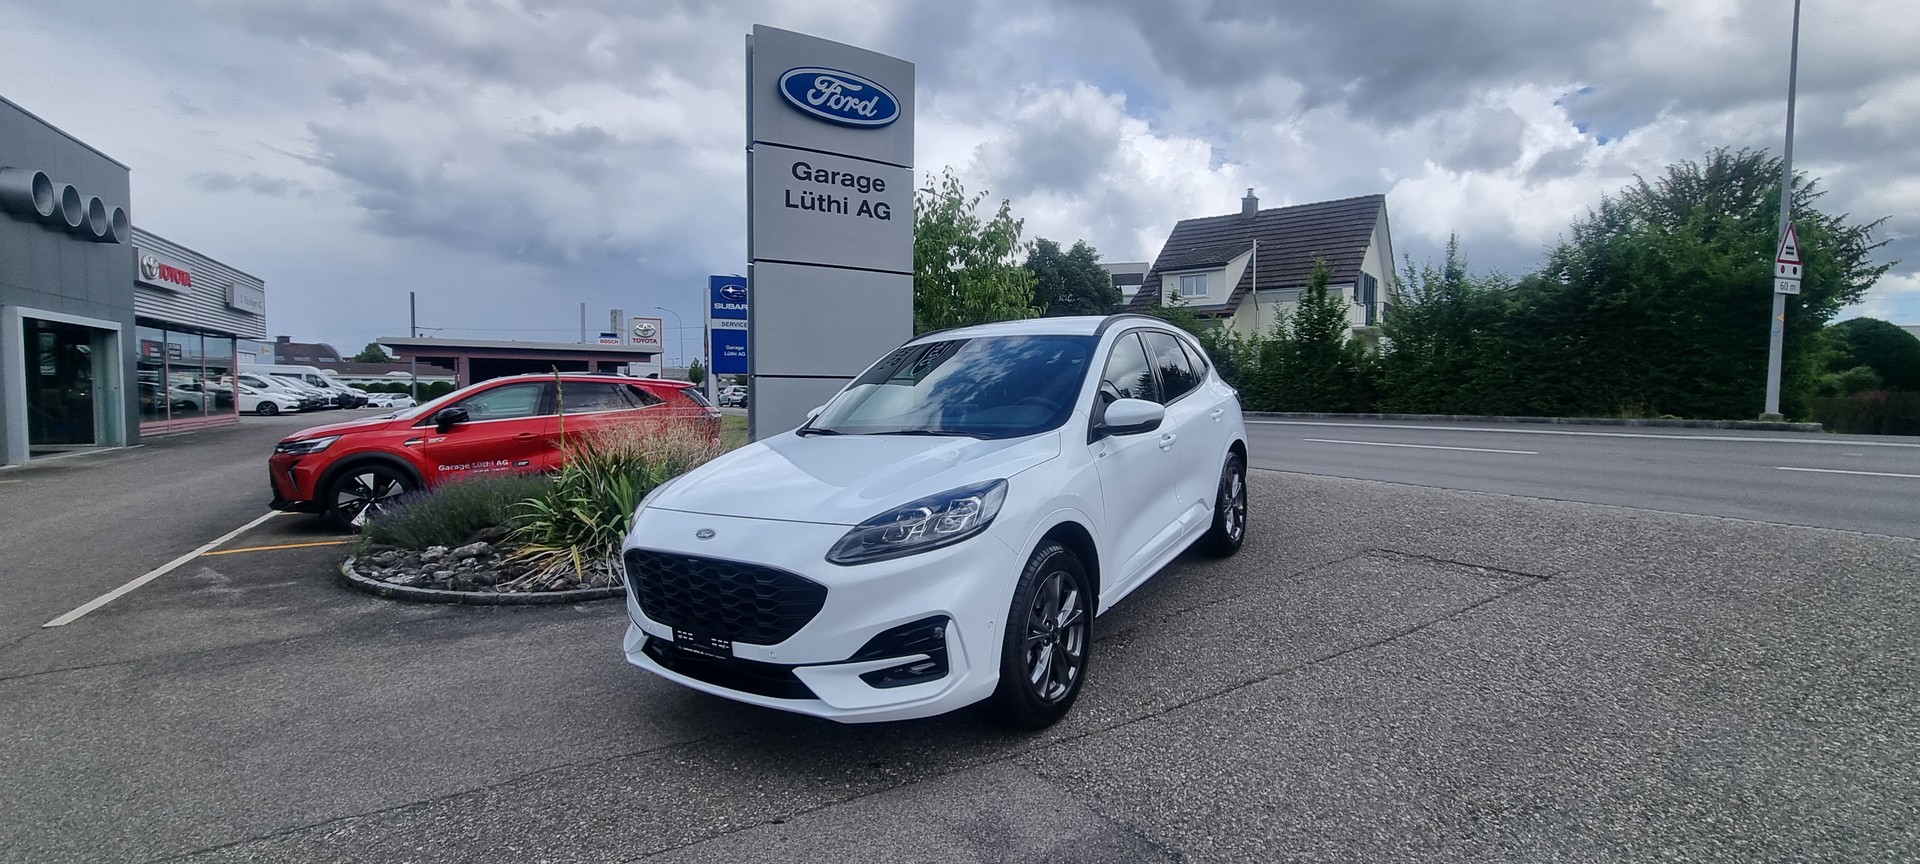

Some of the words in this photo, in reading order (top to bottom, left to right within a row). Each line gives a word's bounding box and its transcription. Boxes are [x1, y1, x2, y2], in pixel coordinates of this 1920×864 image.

[806, 75, 879, 118] Ford
[791, 161, 886, 193] Garage
[785, 189, 848, 215] Lüthi
[856, 199, 891, 221] AG
[159, 263, 191, 287] TOYOTA
[1779, 281, 1789, 291] 60
[438, 462, 470, 472] Garage
[496, 459, 508, 467] AG
